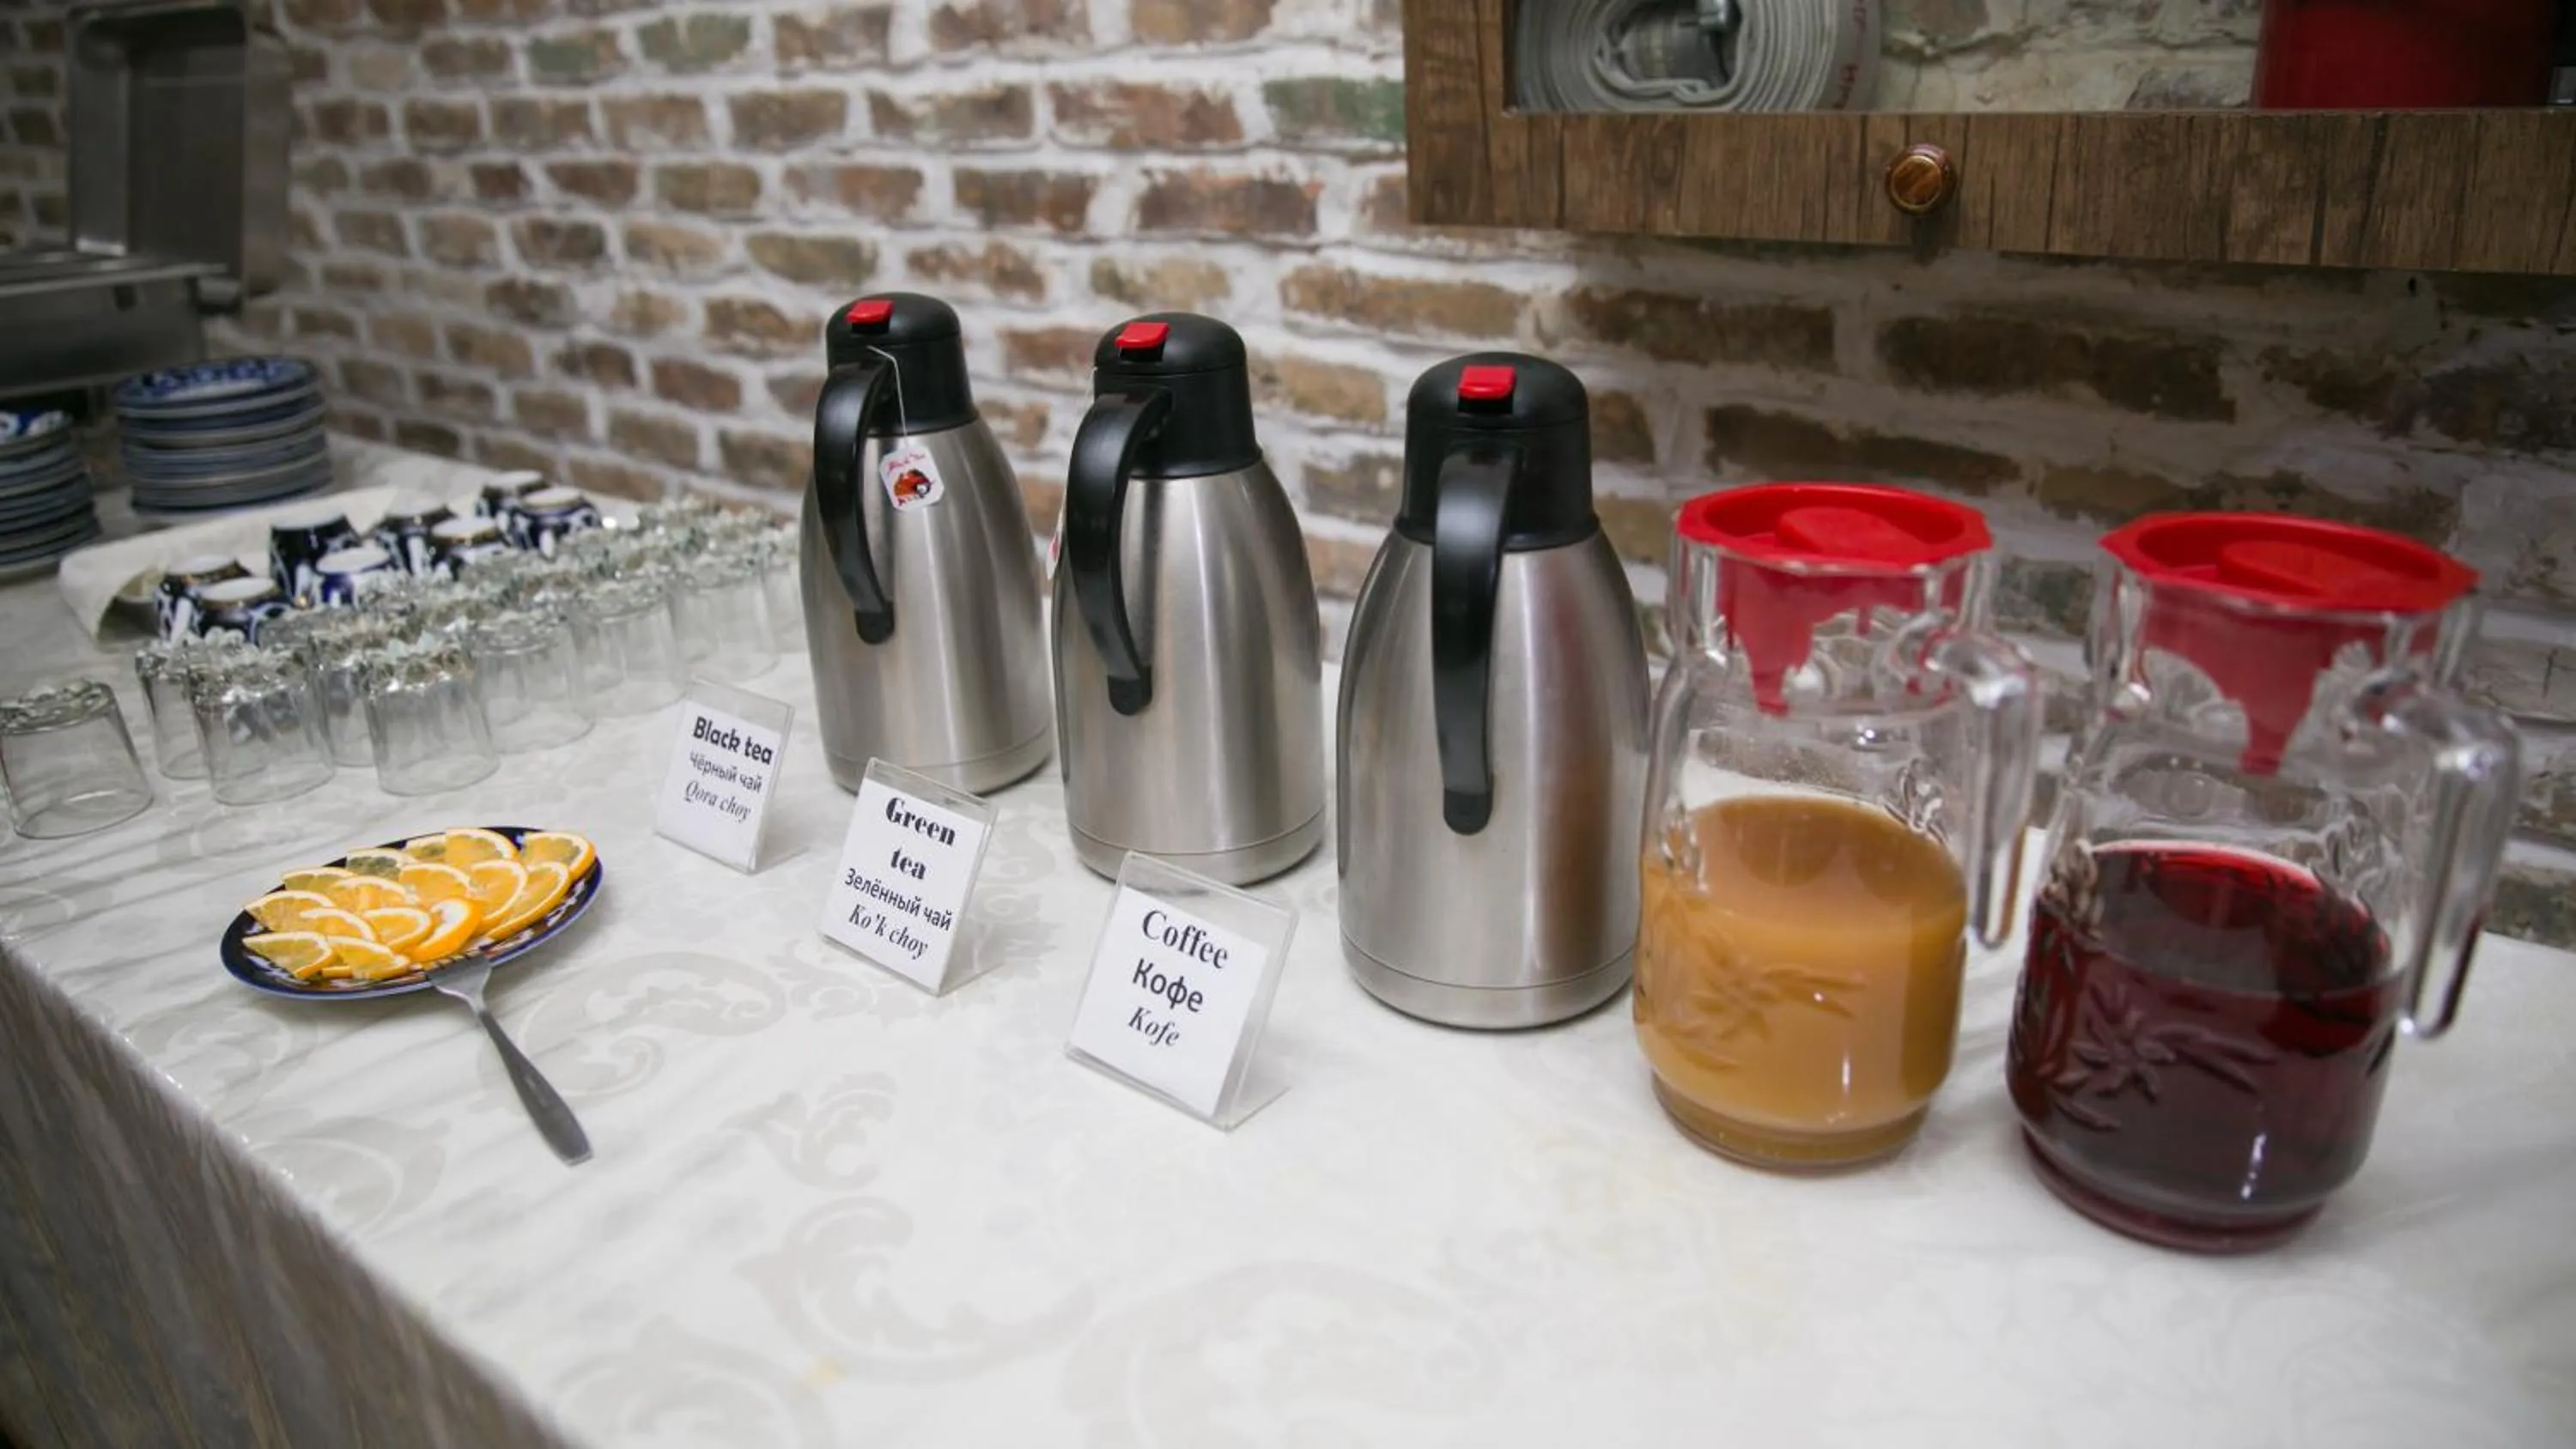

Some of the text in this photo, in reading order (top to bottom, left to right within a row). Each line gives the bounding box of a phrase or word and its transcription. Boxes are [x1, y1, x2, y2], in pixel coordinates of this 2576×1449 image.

[693, 716, 773, 765] Black tea
[683, 779, 751, 823] Qora choy
[739, 774, 762, 793] чай
[885, 797, 956, 846] Green
[890, 847, 927, 880] tea
[844, 868, 953, 931] Зелённый чай
[889, 926, 928, 960] choy
[1141, 909, 1229, 969] Coffee
[1132, 958, 1204, 1013] Кофе
[1128, 1006, 1180, 1046] Kofe
